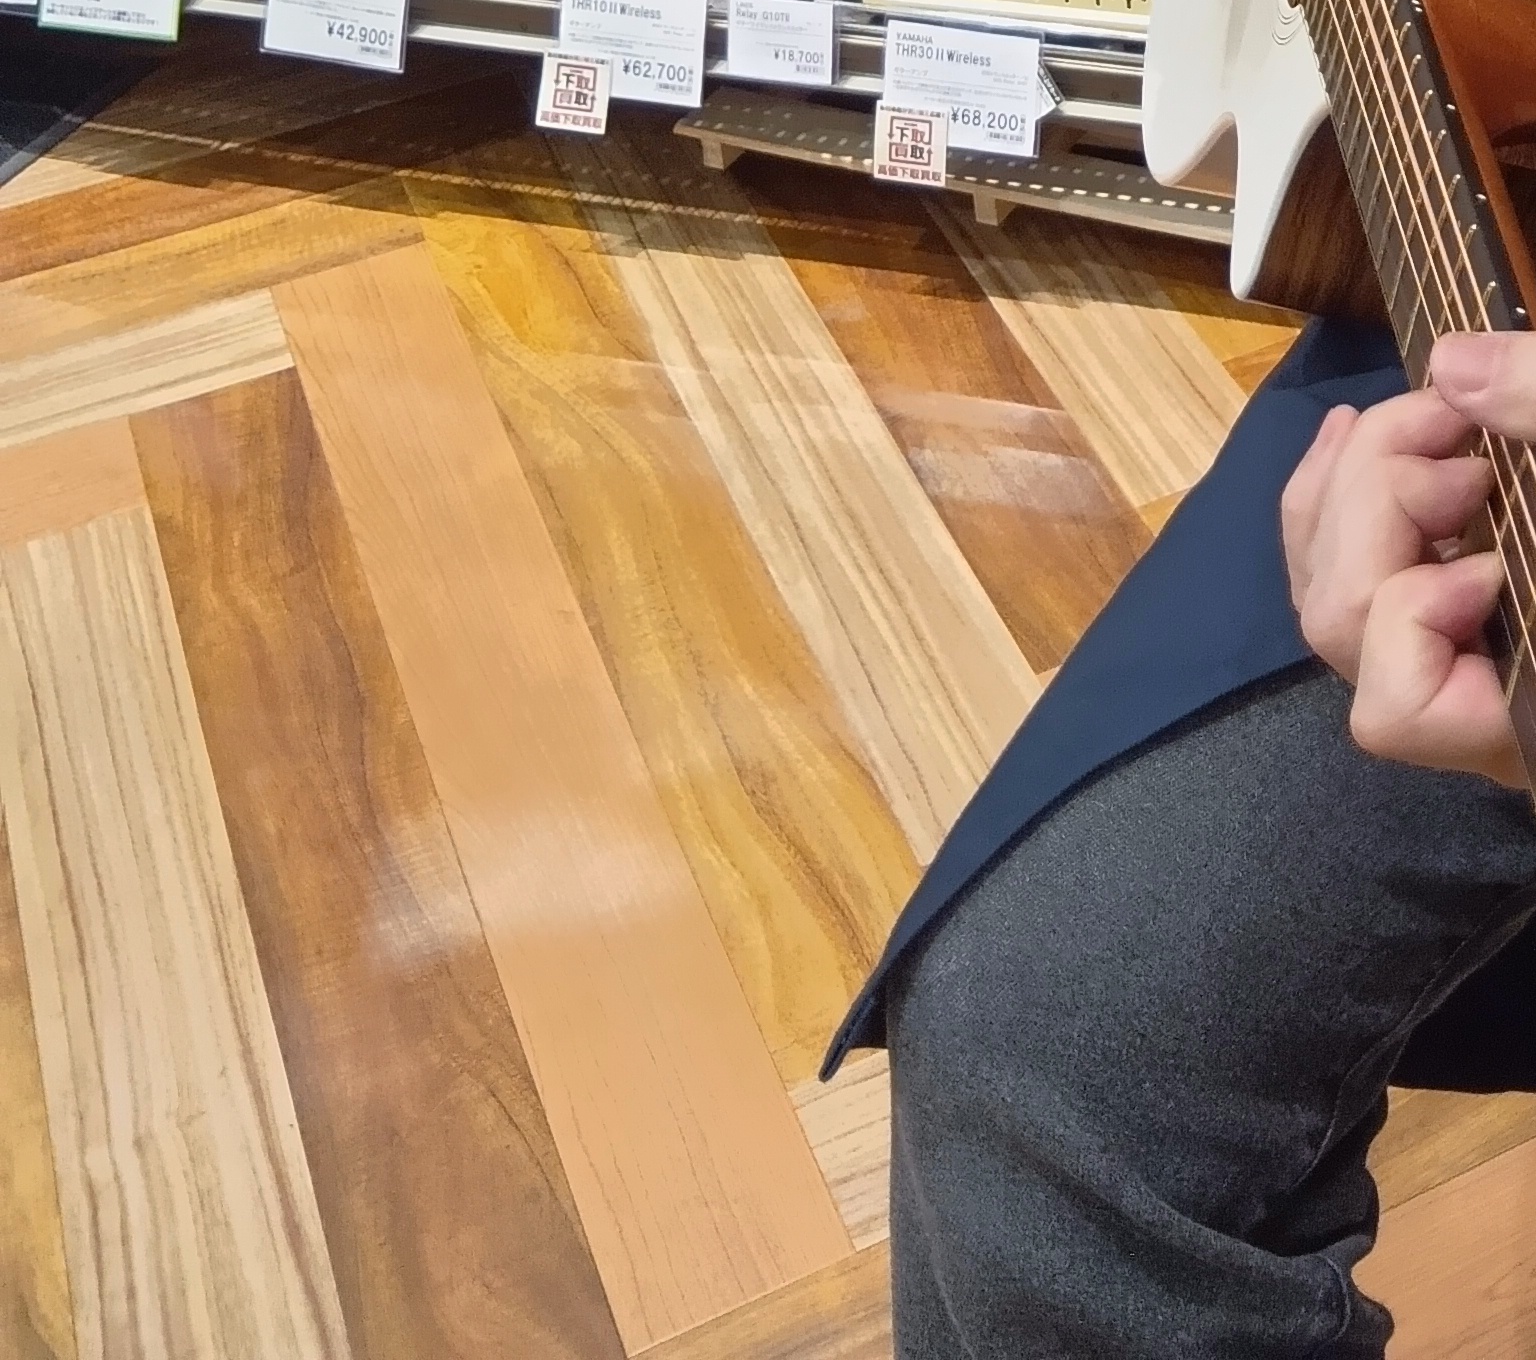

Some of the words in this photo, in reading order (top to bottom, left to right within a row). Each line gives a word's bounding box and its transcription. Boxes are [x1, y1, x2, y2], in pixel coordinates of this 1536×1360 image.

[736, 9, 758, 19] Relay
[326, 21, 388, 47] ¥42,900
[896, 32, 933, 44] YAMAHA
[774, 49, 819, 64] ¥18,700
[622, 58, 687, 83] ¥62,700
[951, 107, 1019, 131] ¥68,200
[895, 126, 925, 144] 下取
[895, 145, 925, 160] 買取
[878, 164, 942, 181] 高価下取買取
